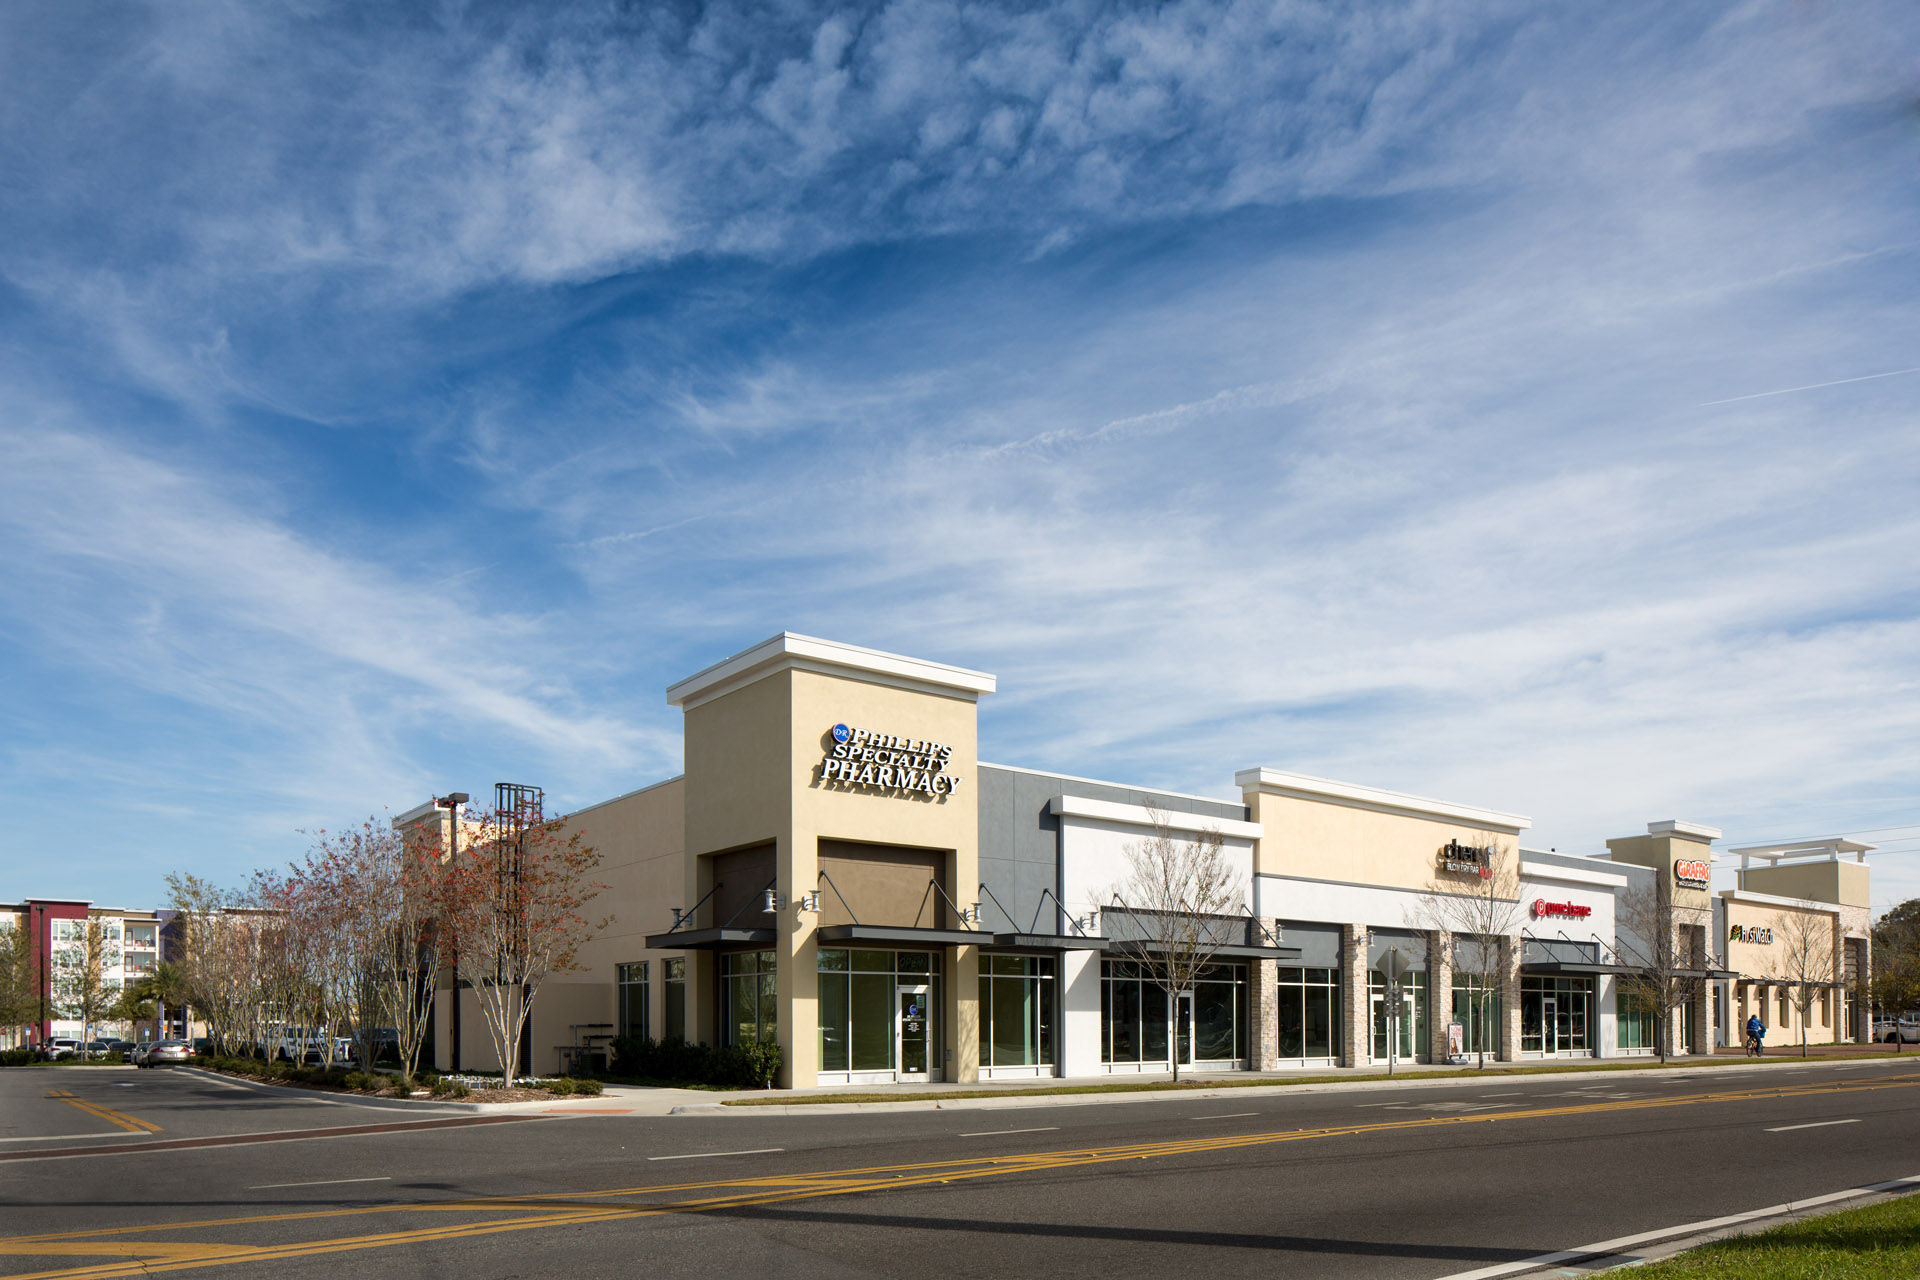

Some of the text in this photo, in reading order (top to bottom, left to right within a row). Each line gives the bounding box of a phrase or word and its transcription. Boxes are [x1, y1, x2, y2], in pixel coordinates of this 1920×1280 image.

[850, 728, 953, 758] PHILLIPS
[832, 744, 951, 772] SPECIALTY
[821, 758, 963, 795] PHARMACY
[1470, 865, 1480, 874] BAR
